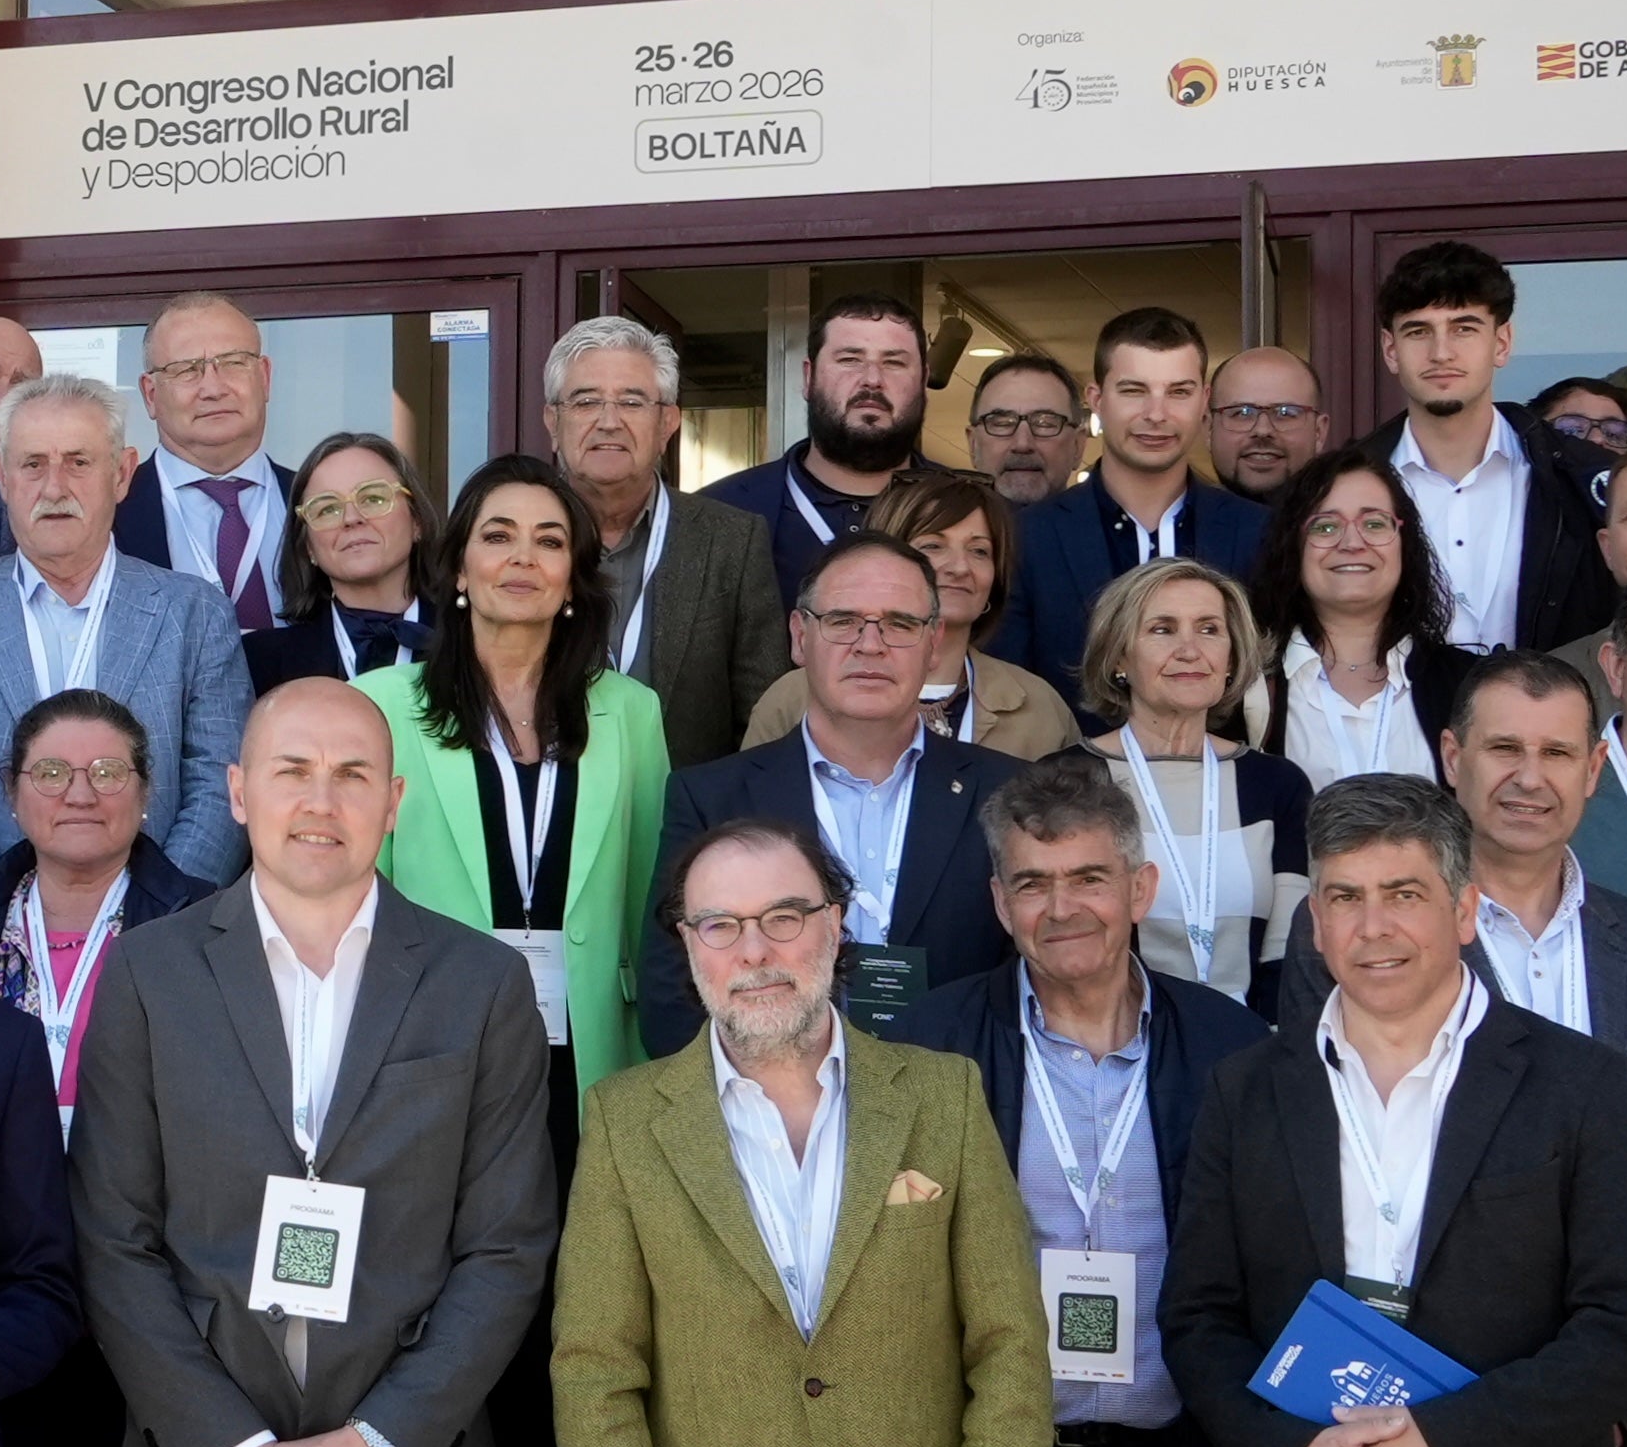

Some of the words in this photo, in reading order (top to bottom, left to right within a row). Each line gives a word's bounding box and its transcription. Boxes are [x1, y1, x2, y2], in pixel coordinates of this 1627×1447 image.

[1017, 29, 1085, 48] Organiza:
[1228, 60, 1327, 79] DIPUTACIÓN
[1579, 61, 1608, 79] DE
[83, 82, 107, 112] V
[114, 74, 289, 114] Congreso
[297, 56, 454, 98] Nacional
[636, 80, 732, 106] marzo
[739, 68, 824, 100] 2026
[1228, 76, 1326, 92] HUESCA
[82, 120, 127, 152] de
[135, 107, 312, 148] Desarrollo
[320, 99, 409, 137] Rural
[649, 120, 807, 161] BOLTAÑA
[82, 166, 100, 200] y
[108, 144, 346, 194] Despoblación
[290, 1204, 335, 1216] PROGRAMA
